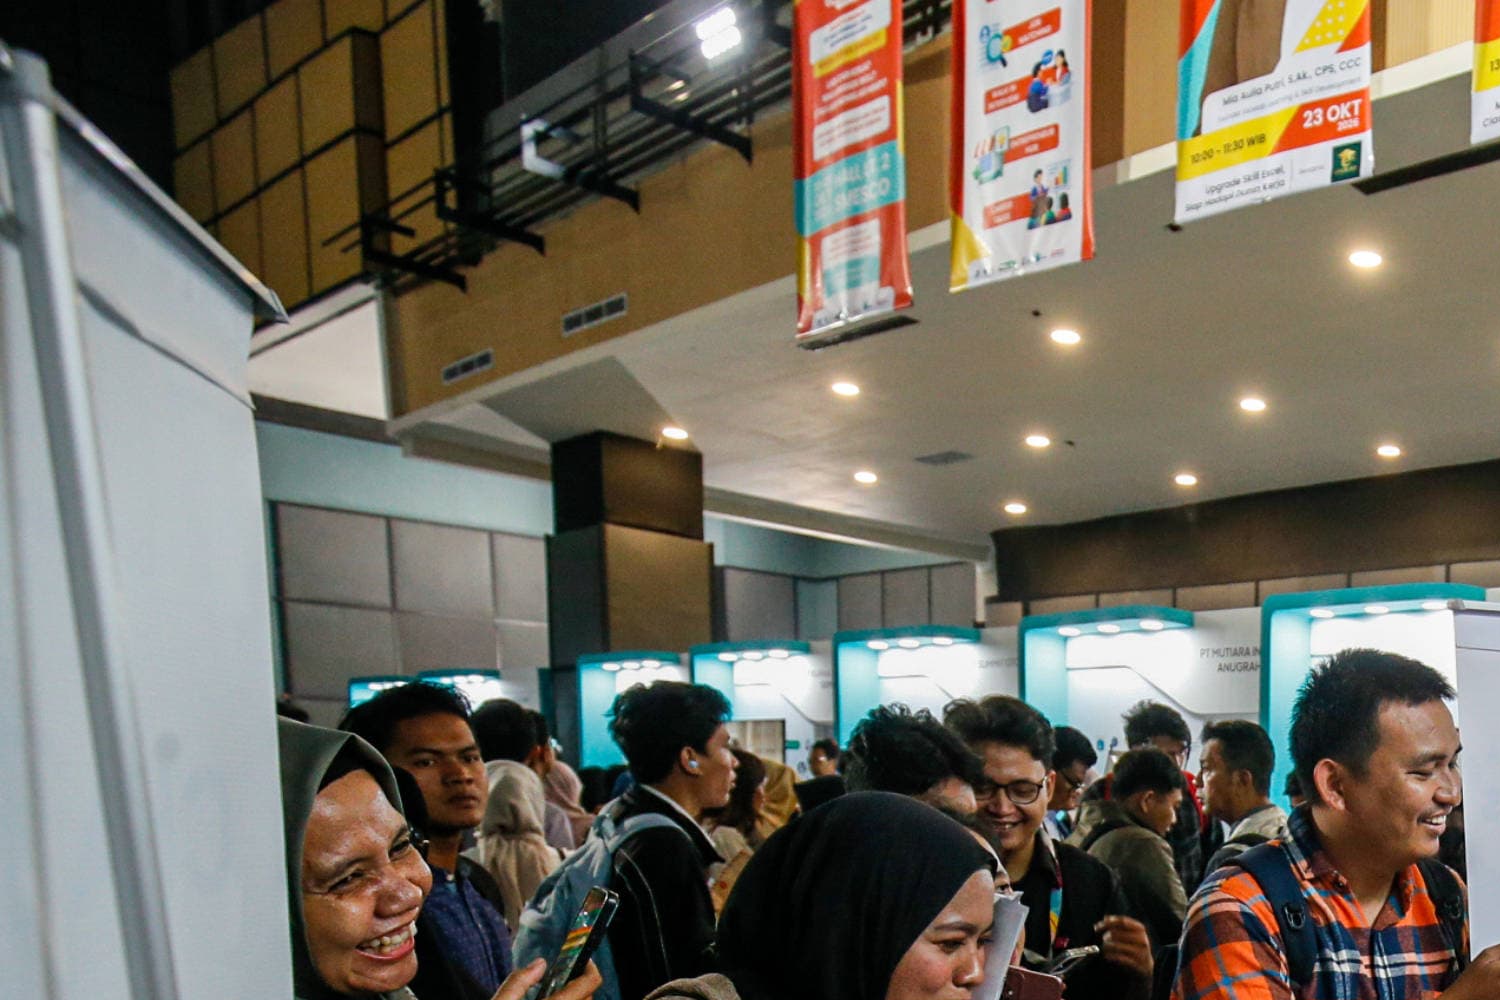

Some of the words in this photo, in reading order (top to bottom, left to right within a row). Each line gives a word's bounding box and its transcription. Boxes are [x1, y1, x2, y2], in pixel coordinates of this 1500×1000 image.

[1315, 63, 1336, 77] CPS,
[1339, 57, 1362, 71] CCC
[1302, 107, 1323, 129] 23
[1326, 98, 1362, 124] OKT
[1191, 148, 1214, 164] 10:00
[1223, 138, 1244, 154] 11:30
[1246, 133, 1267, 148] WIB
[1210, 646, 1251, 658] MUTIARA
